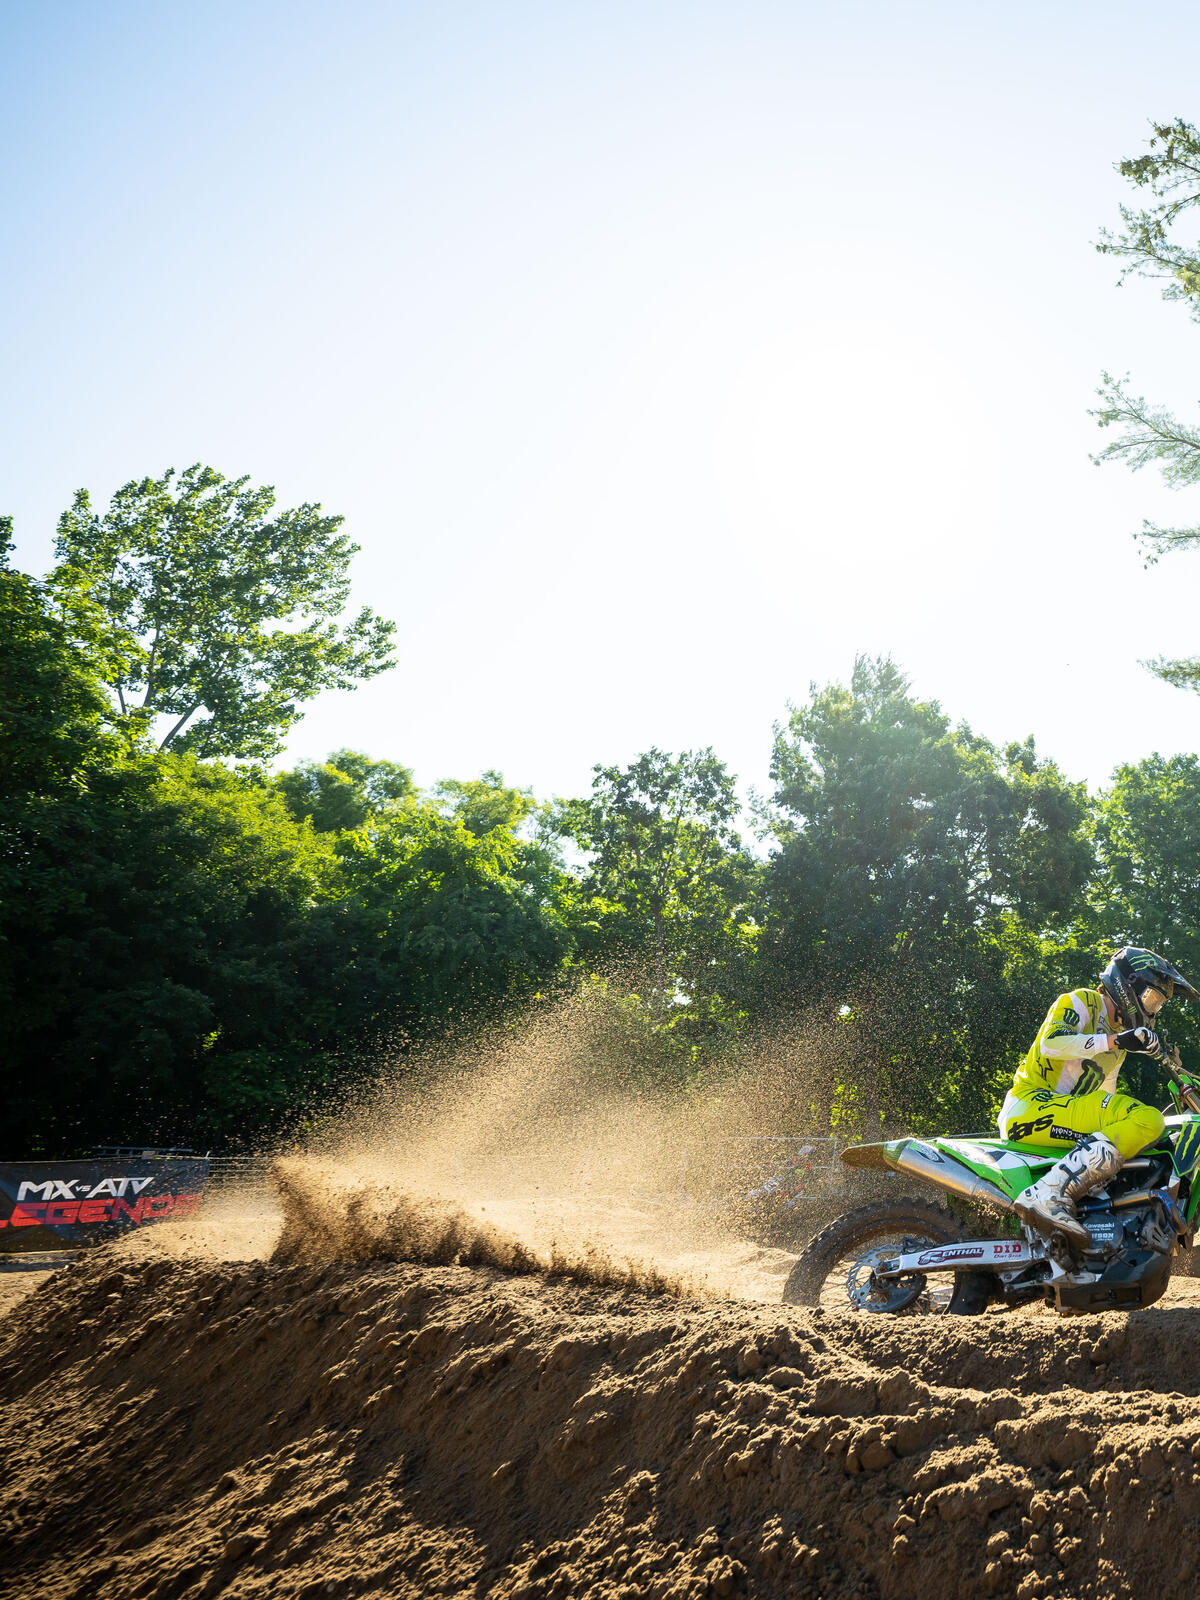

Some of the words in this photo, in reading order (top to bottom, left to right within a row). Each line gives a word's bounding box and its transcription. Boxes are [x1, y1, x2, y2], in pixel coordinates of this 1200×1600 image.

[17, 1179, 80, 1200] MX
[85, 1177, 154, 1199] ATV
[0, 1194, 202, 1229] EGENDS
